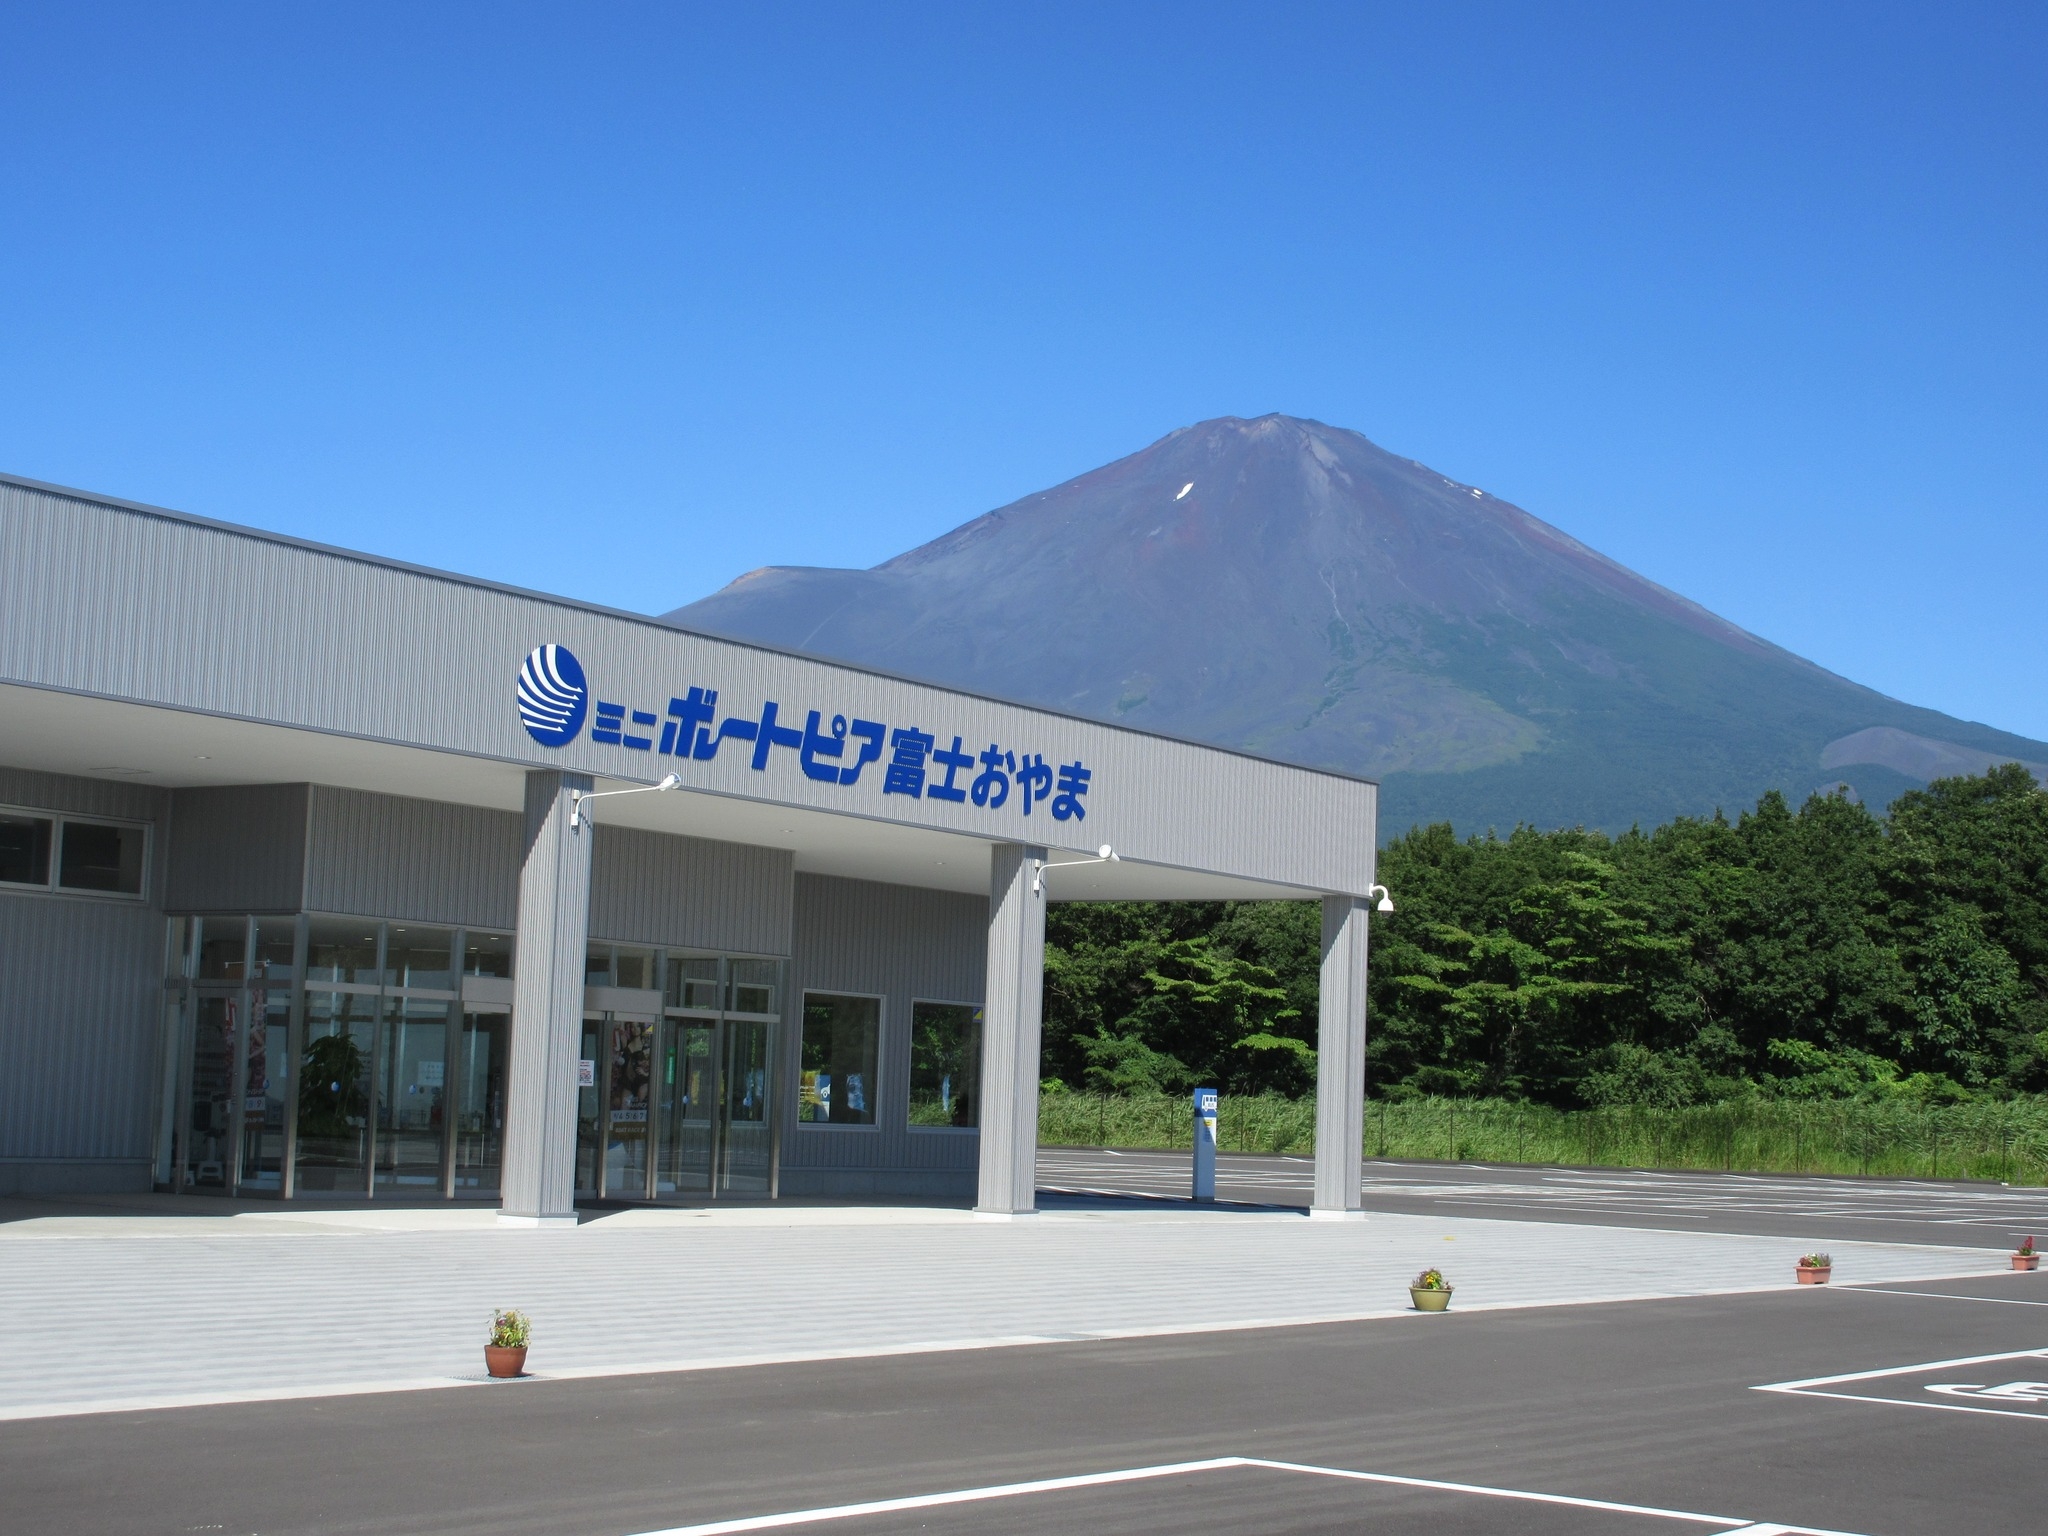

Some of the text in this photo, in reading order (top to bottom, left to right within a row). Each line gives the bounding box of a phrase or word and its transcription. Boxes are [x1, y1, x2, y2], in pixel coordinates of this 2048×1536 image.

[592, 687, 1092, 821] ミニボートピア富士おやま
